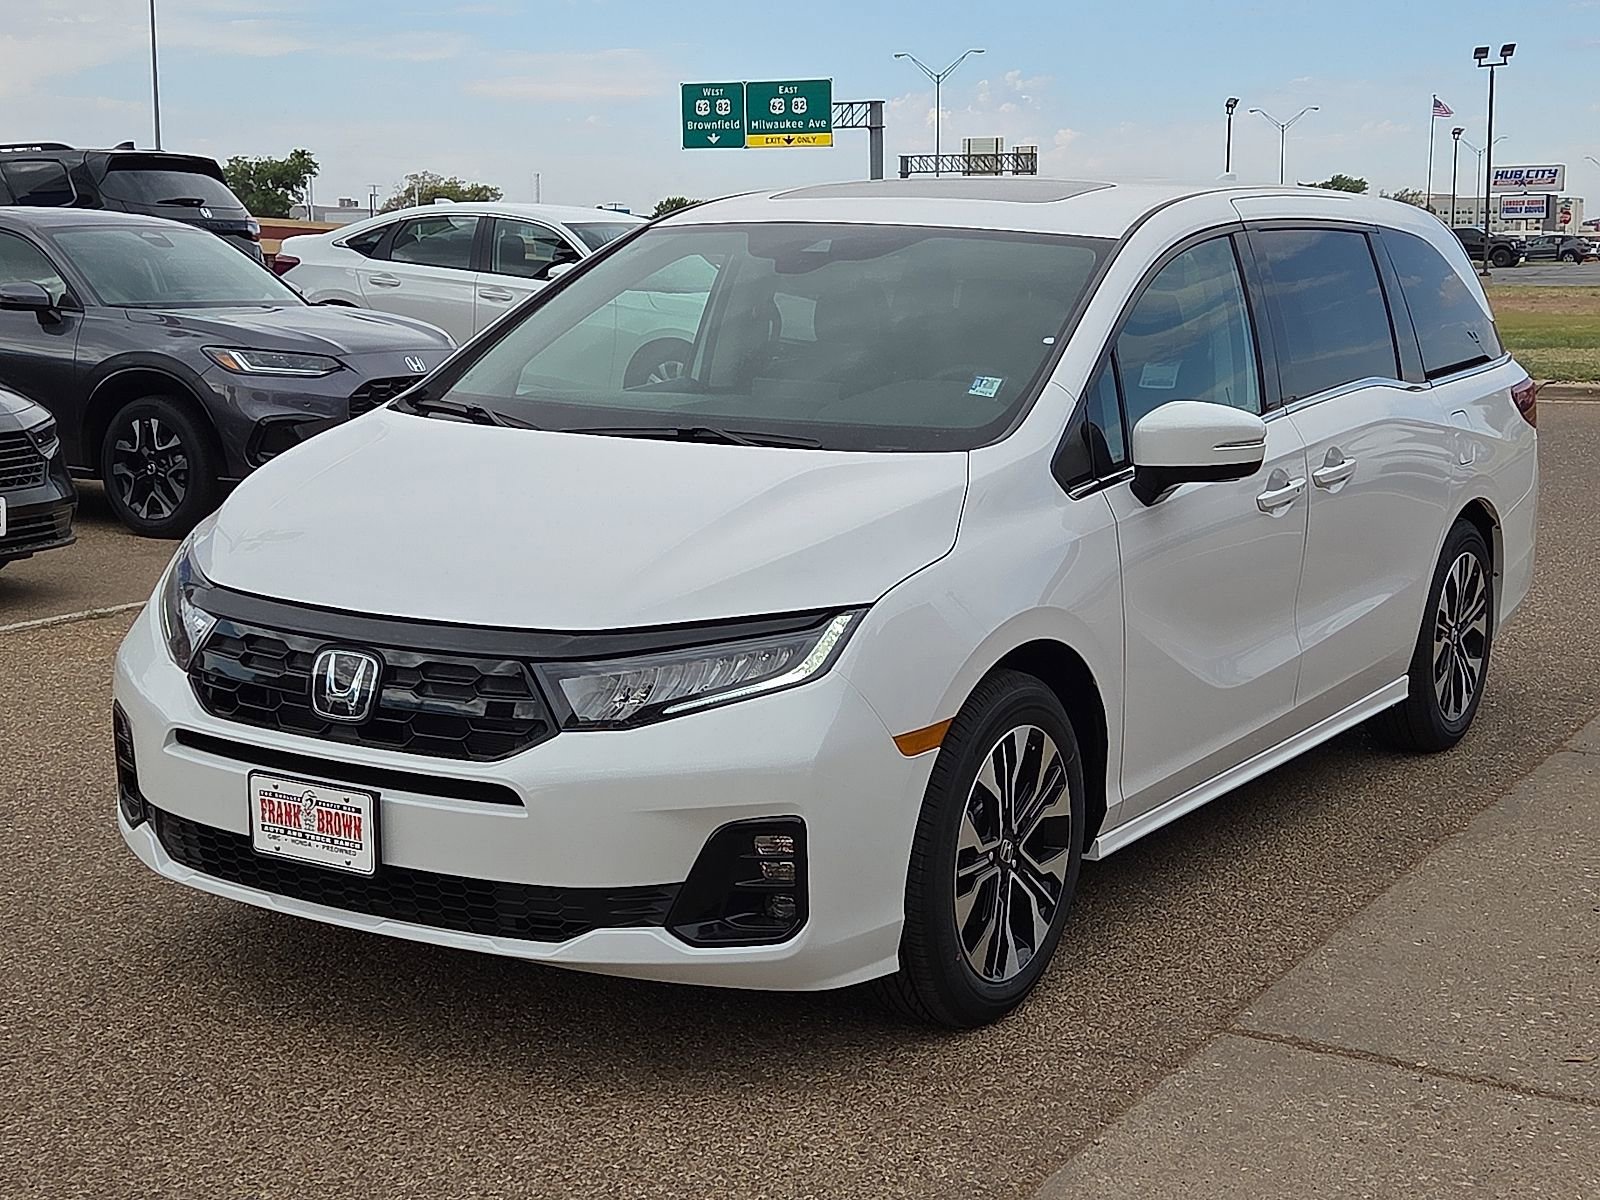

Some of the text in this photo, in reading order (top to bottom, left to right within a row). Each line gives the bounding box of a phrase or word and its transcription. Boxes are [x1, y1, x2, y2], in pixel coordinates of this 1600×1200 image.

[778, 86, 798, 94] EAST
[697, 102, 729, 112] 62 82
[771, 100, 806, 112] 62 82
[687, 120, 740, 130] Brownfield
[751, 118, 827, 130] Milwaukee Ave
[765, 137, 781, 145] EXIT
[1494, 169, 1558, 179] HUB CITY
[260, 798, 362, 841] FRANK BROWN
[263, 825, 361, 850] AUTO AND TRUCK RANCH
[291, 839, 312, 847] HONDA
